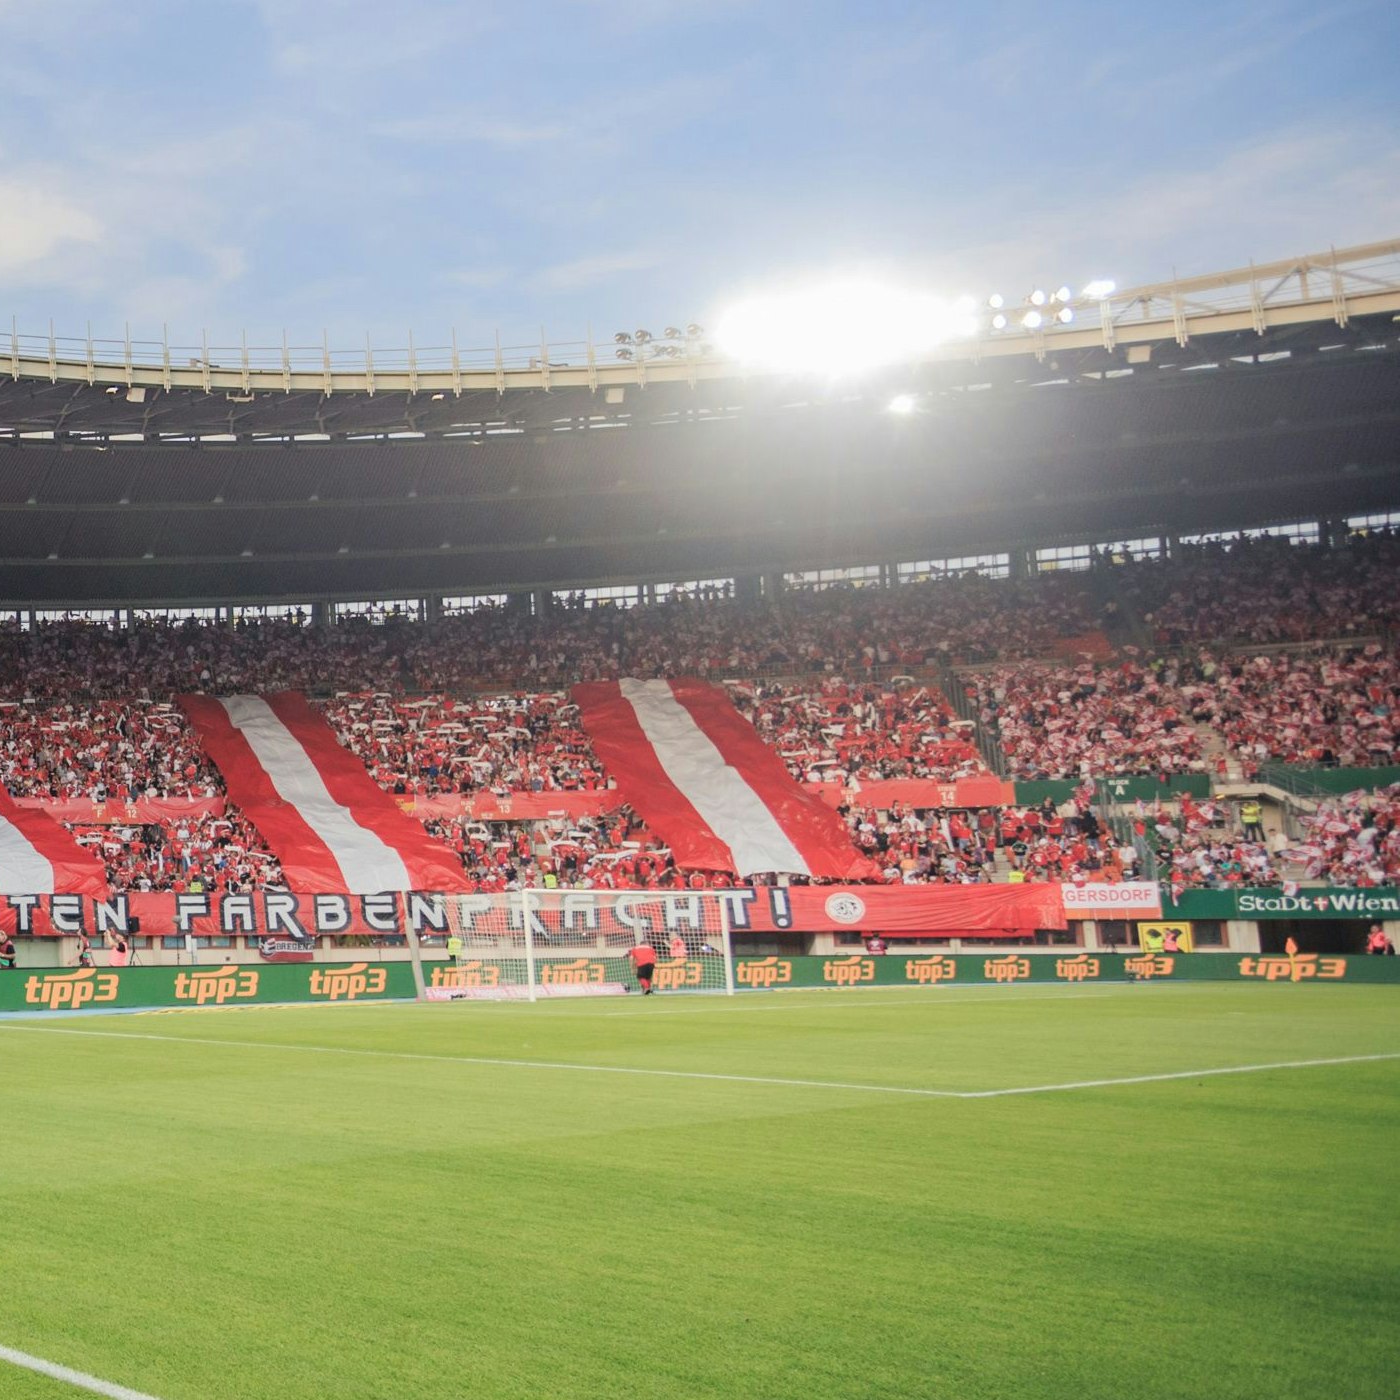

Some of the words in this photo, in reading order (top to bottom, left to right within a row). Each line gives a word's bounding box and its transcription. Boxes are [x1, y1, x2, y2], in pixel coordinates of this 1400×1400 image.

[1115, 785, 1125, 795] A
[1329, 893, 1399, 911] Wien
[25, 968, 119, 1009] tipp3
[175, 964, 259, 1004] tipp3
[309, 961, 387, 1000] tipp3
[652, 956, 703, 990] ipp3
[736, 957, 792, 987] tipp3
[824, 956, 875, 985] tipp3
[906, 955, 956, 984] tipp3
[984, 955, 1030, 982] tipp3
[1056, 954, 1099, 981] tipp3
[1125, 954, 1174, 979] tipp3
[1238, 954, 1347, 981] tipp3
